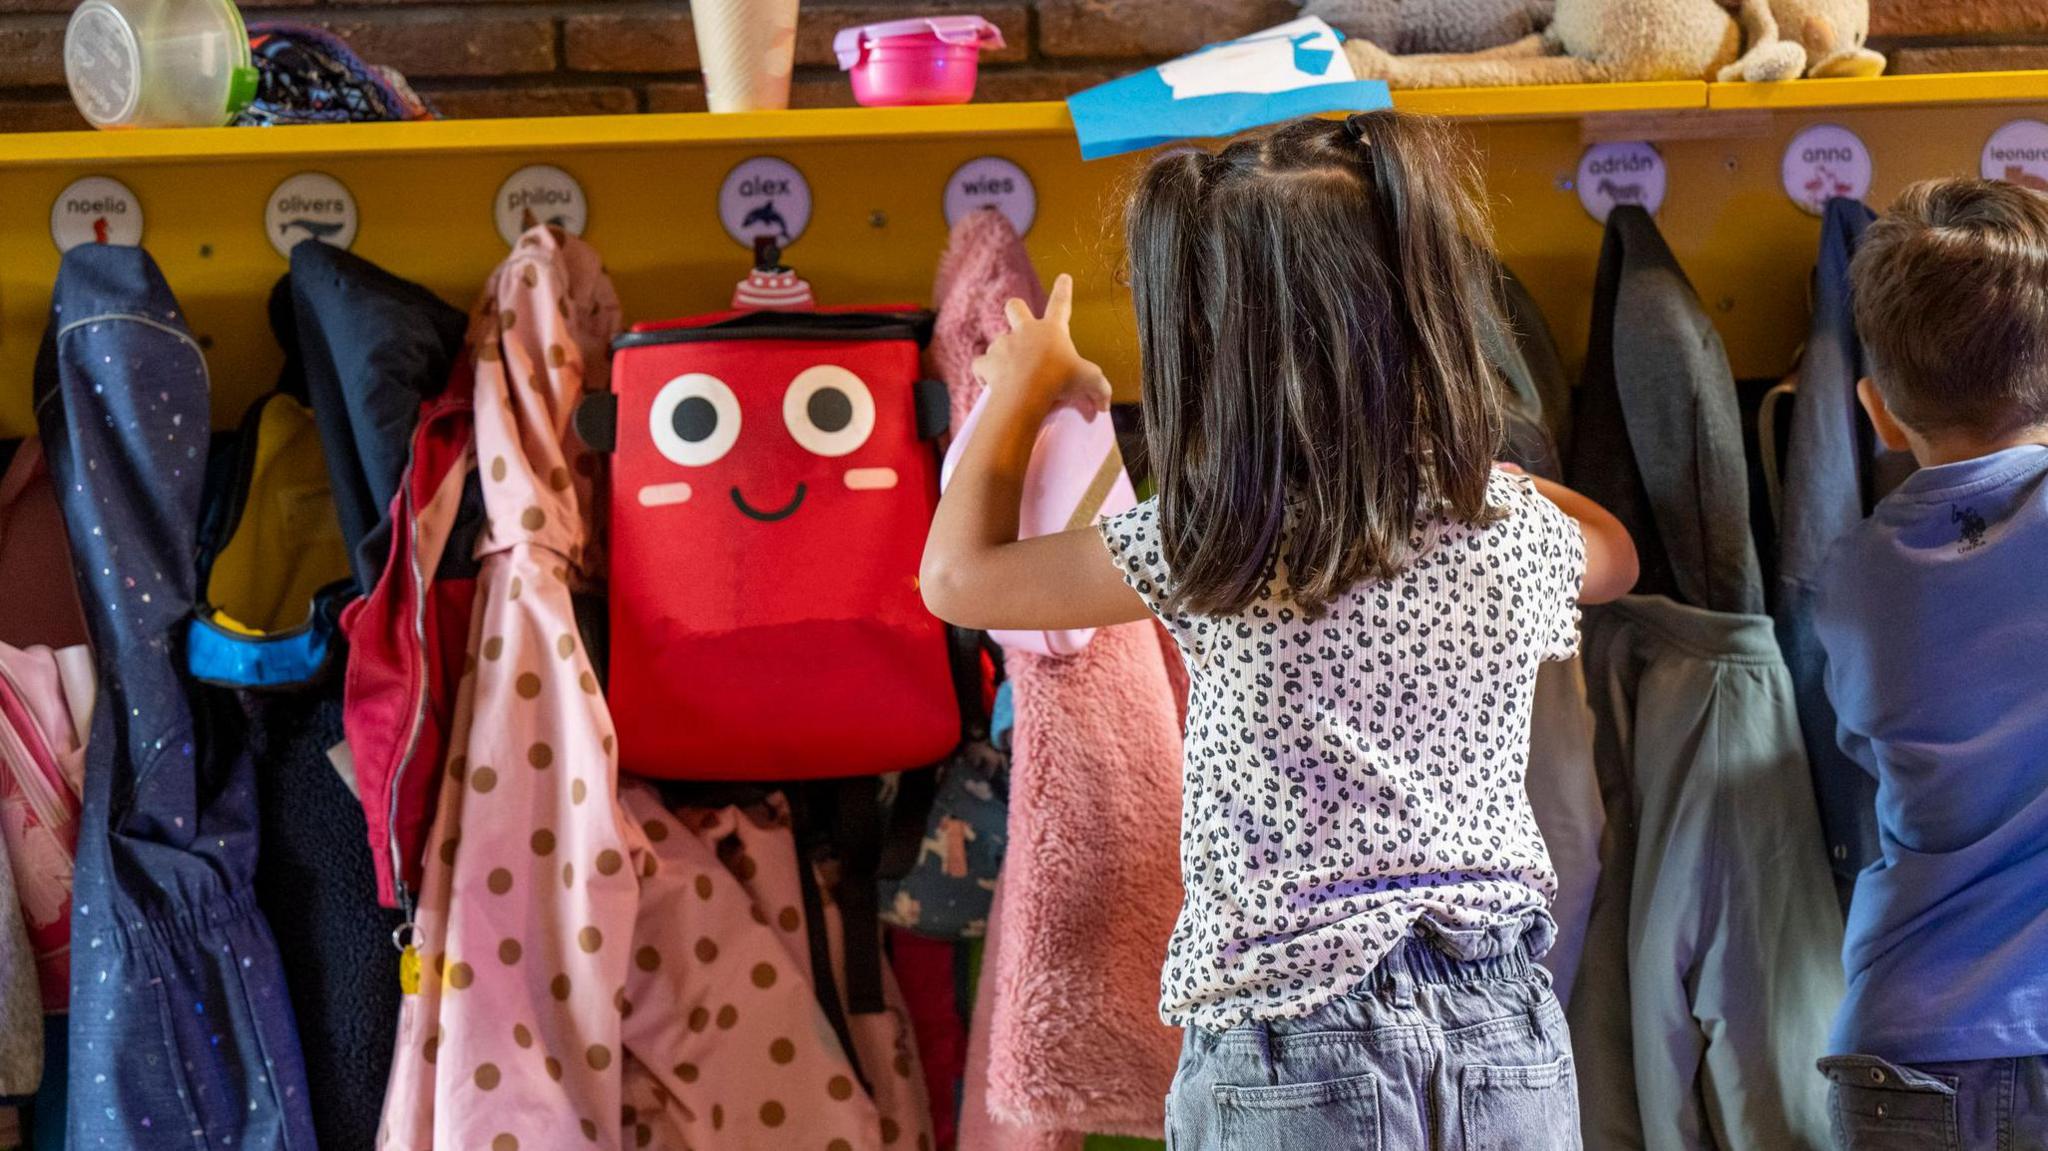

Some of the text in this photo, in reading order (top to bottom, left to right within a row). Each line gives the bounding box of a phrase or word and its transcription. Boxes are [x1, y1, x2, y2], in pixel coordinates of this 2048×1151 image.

[1589, 152, 1653, 174] adrián
[1802, 147, 1852, 163] anna
[740, 178, 790, 198] alex
[964, 178, 1014, 195] wies
[68, 196, 127, 214] noelia
[279, 195, 346, 214] olivers
[508, 188, 571, 211] philou
